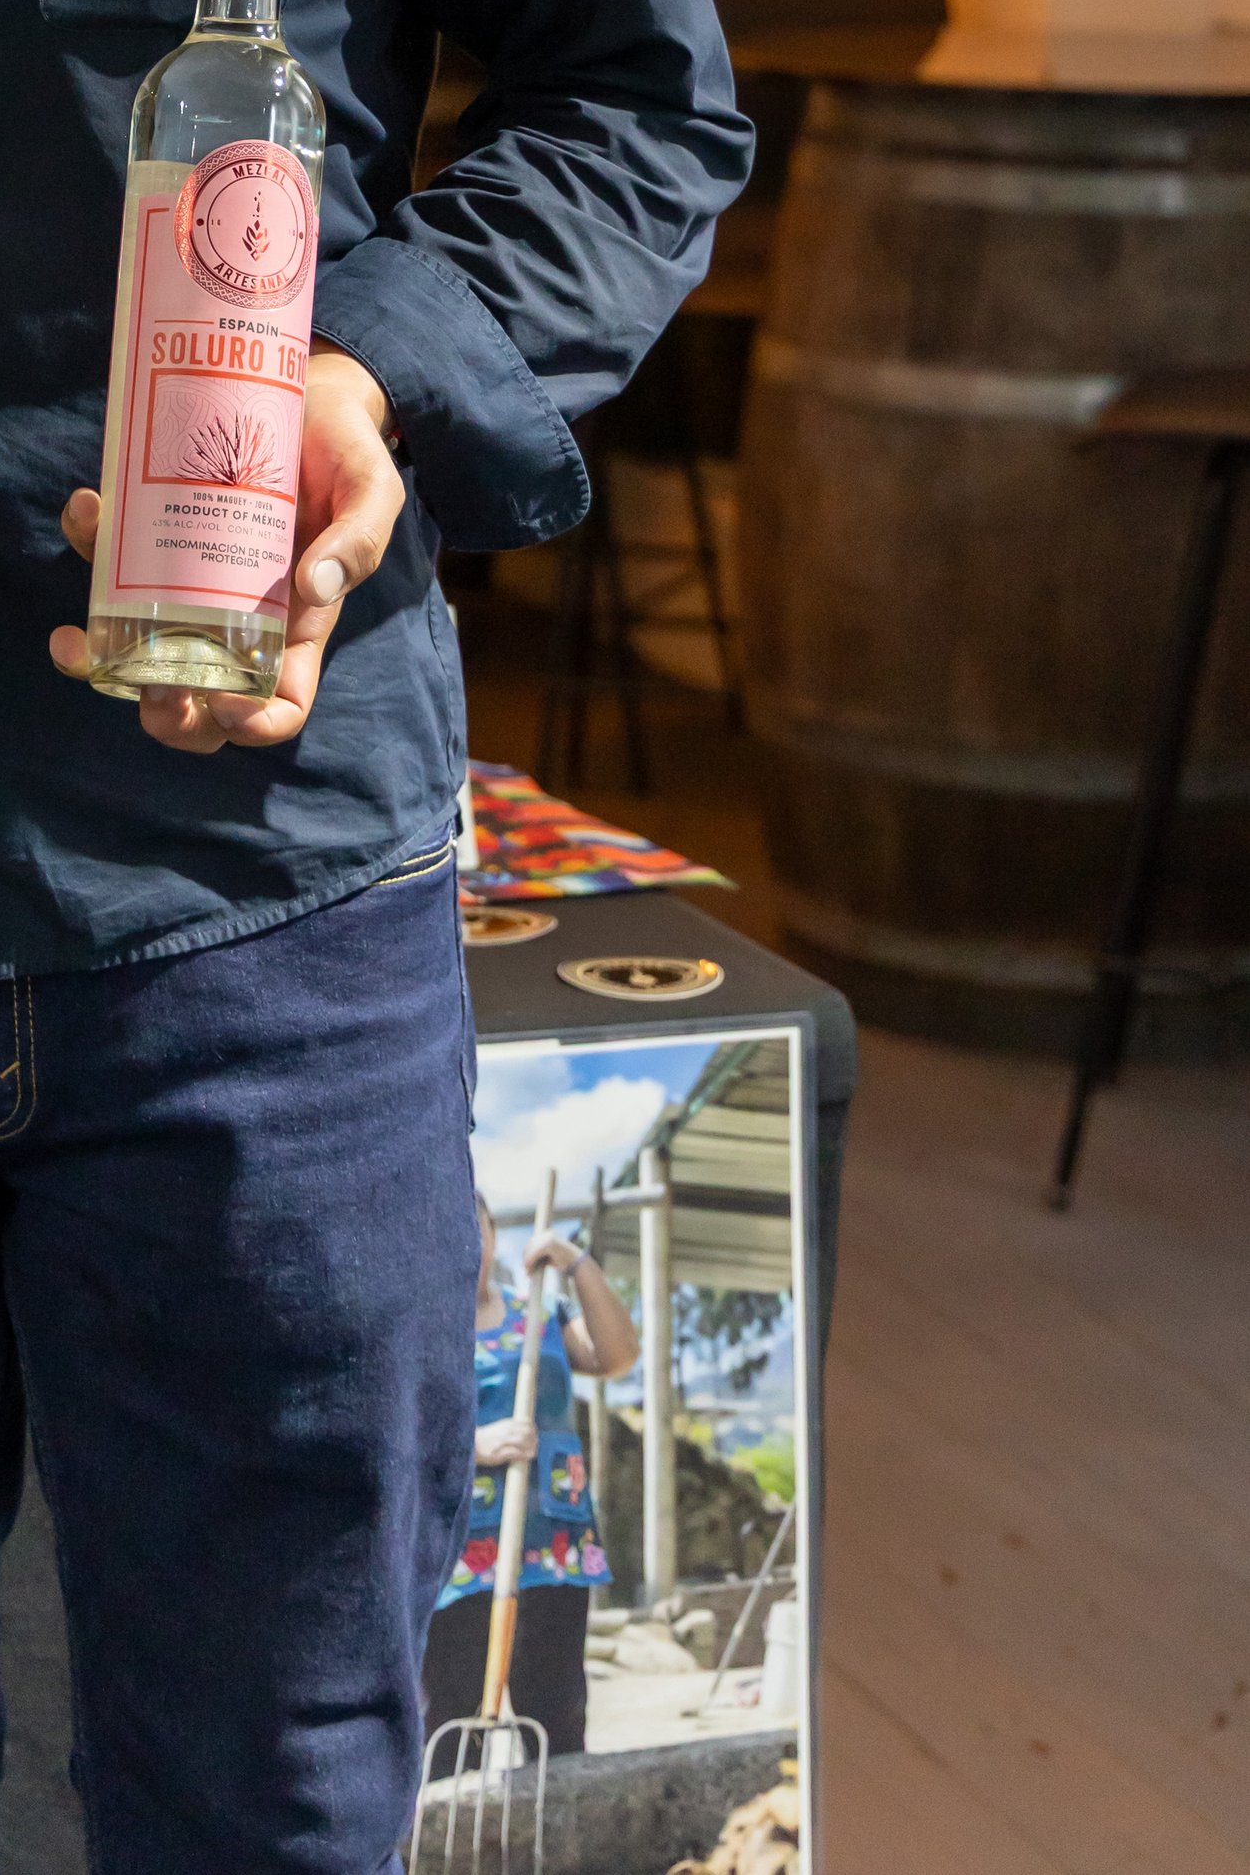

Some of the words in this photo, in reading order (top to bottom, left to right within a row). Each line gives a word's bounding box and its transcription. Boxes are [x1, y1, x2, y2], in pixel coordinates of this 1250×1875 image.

[213, 262, 290, 292] ARTESANAL
[219, 317, 279, 337] ESPADÍN
[151, 332, 264, 372] SOLURO
[193, 492, 213, 502] 100%
[217, 494, 246, 506] MAGUEY
[165, 504, 229, 518] PRODUCT
[232, 510, 249, 521] OF
[251, 513, 286, 530] MÉXICO
[155, 538, 246, 555] DENOMINACIÓN
[248, 547, 260, 558] DE
[261, 550, 286, 565] ORIGEN
[201, 552, 260, 569] PROTEGIDA
